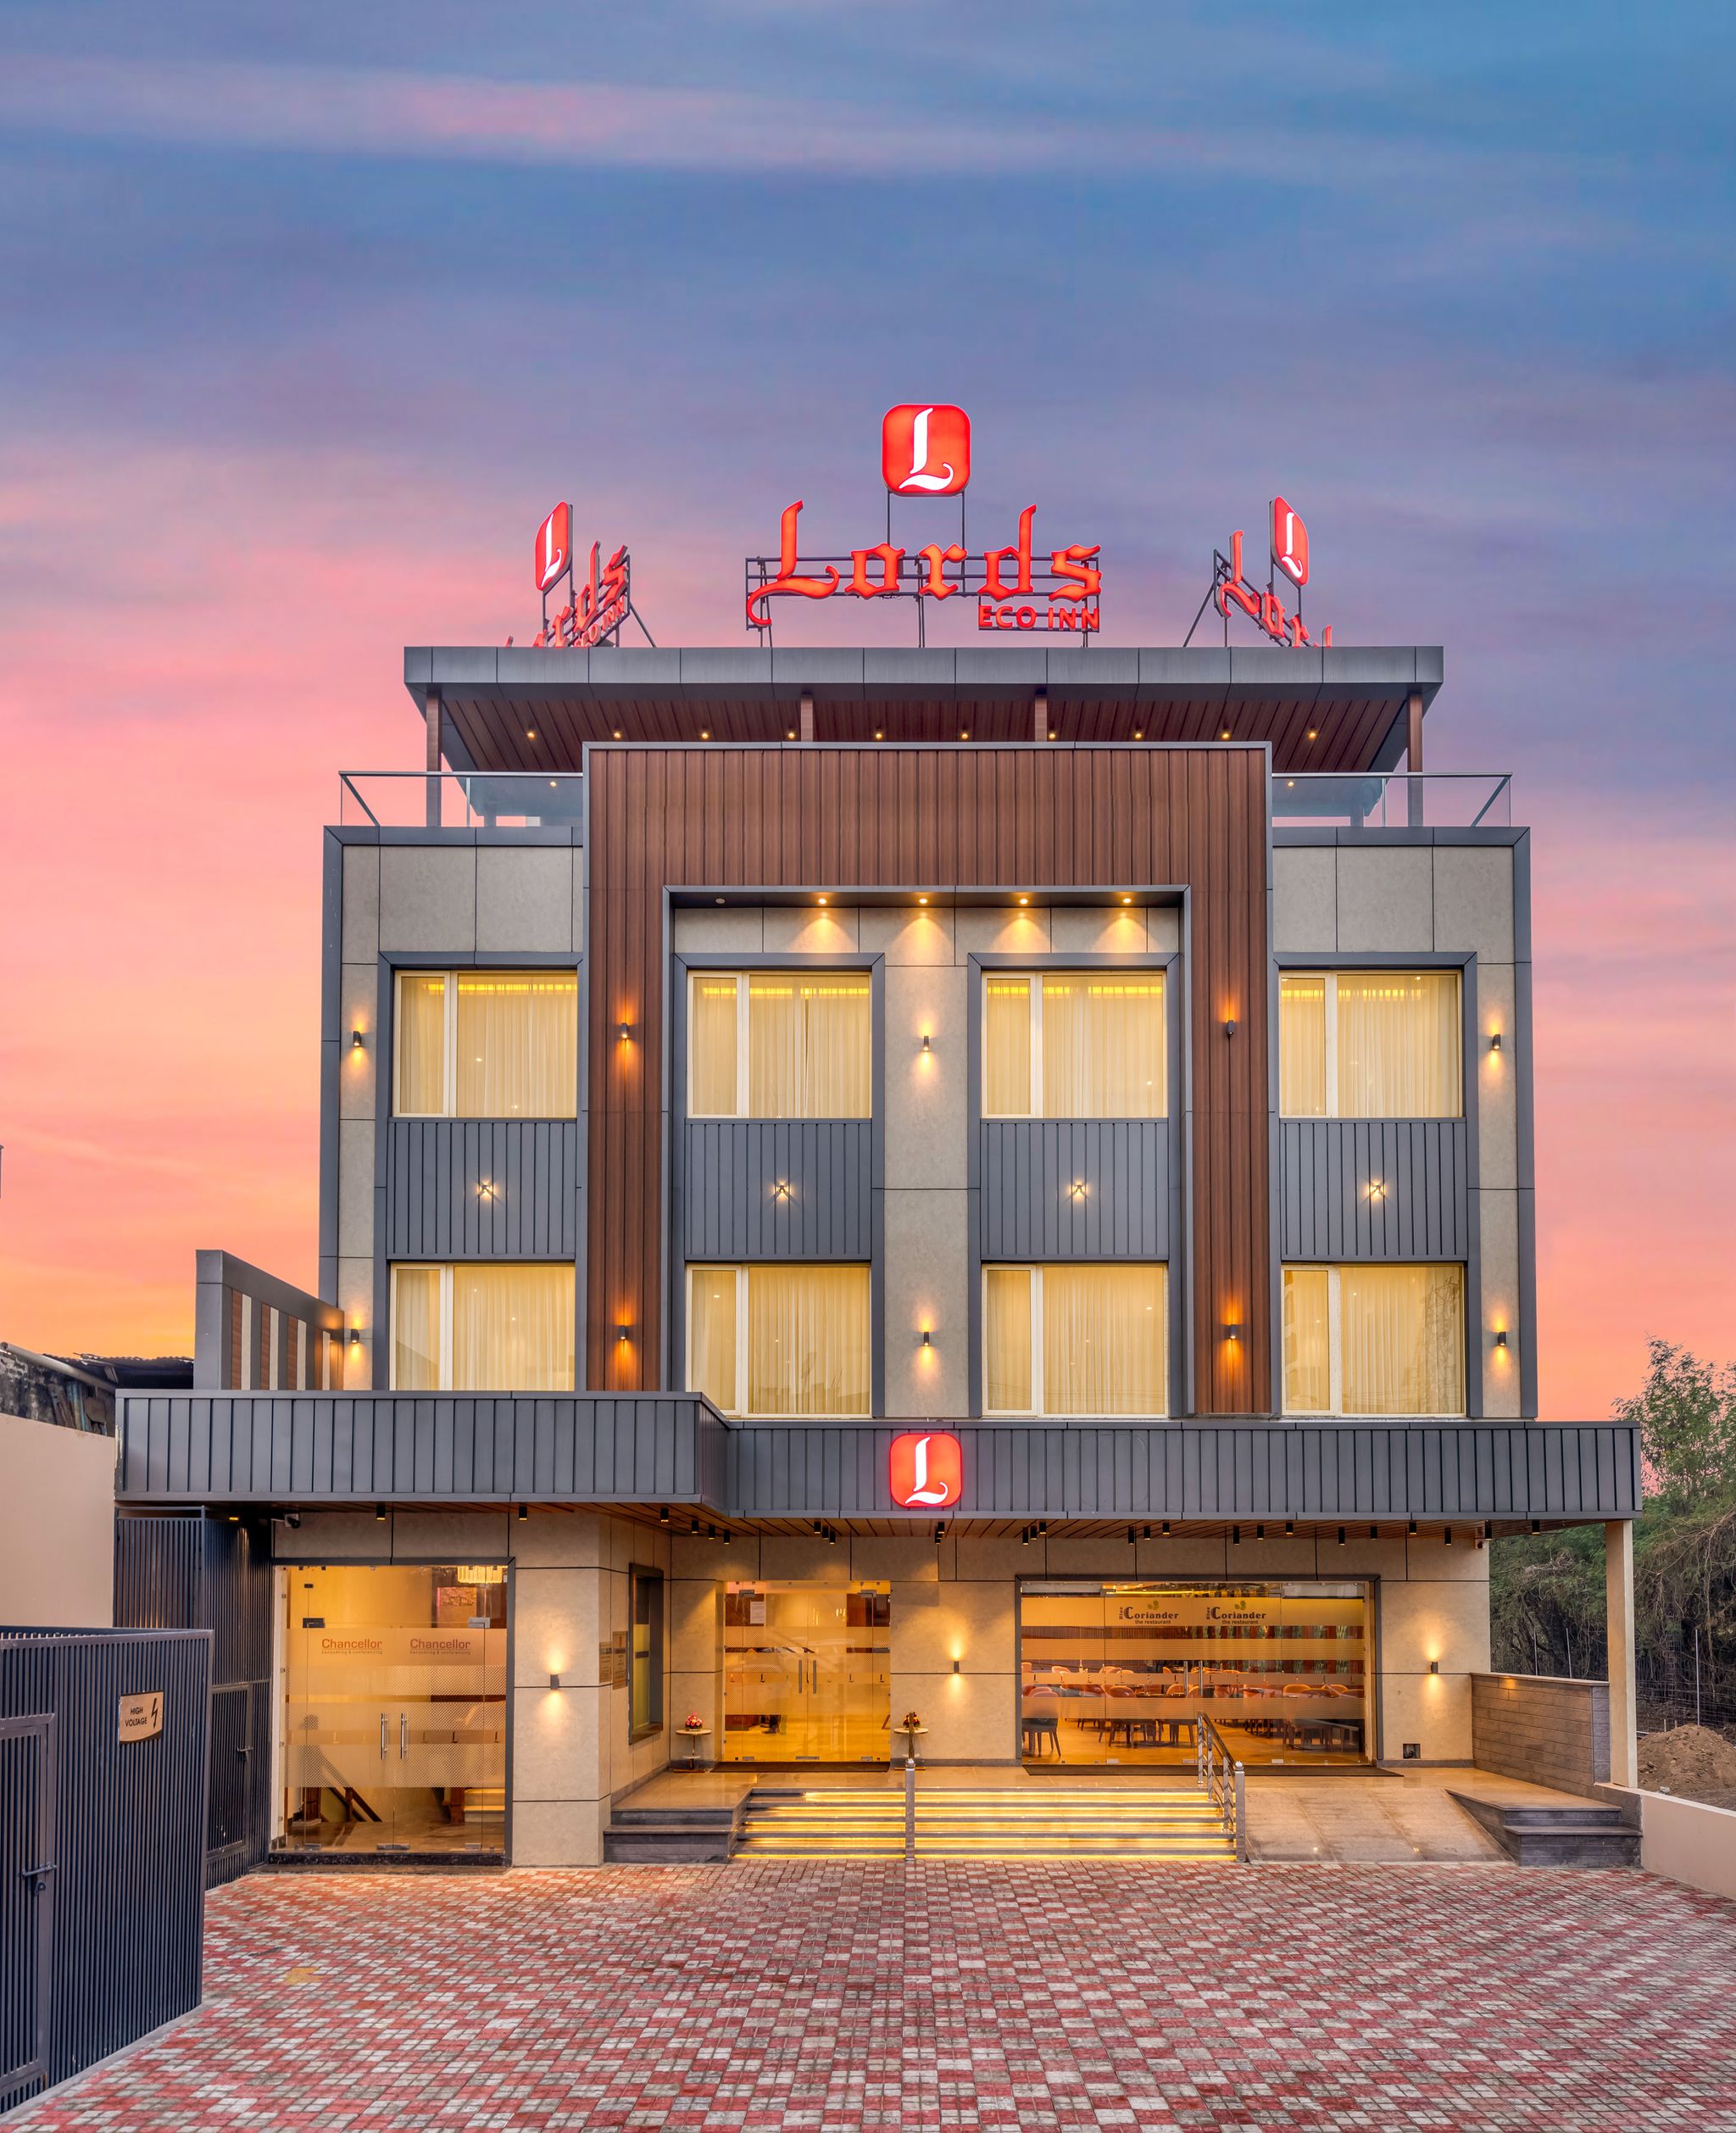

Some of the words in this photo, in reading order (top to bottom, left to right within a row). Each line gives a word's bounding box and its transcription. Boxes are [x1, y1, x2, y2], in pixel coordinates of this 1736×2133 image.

[899, 408, 954, 491] L
[541, 513, 562, 588] L
[746, 500, 1102, 627] Lords
[977, 604, 1037, 629] ECO
[1048, 607, 1099, 631] INN
[904, 1436, 949, 1505] L
[1124, 1606, 1179, 1620] Coriander
[1210, 1606, 1266, 1620] Coriander
[321, 1638, 382, 1649] Chancellor
[409, 1638, 471, 1649] Chancellor
[130, 1707, 144, 1715] HIGH
[125, 1717, 147, 1727] VOLTAGE
